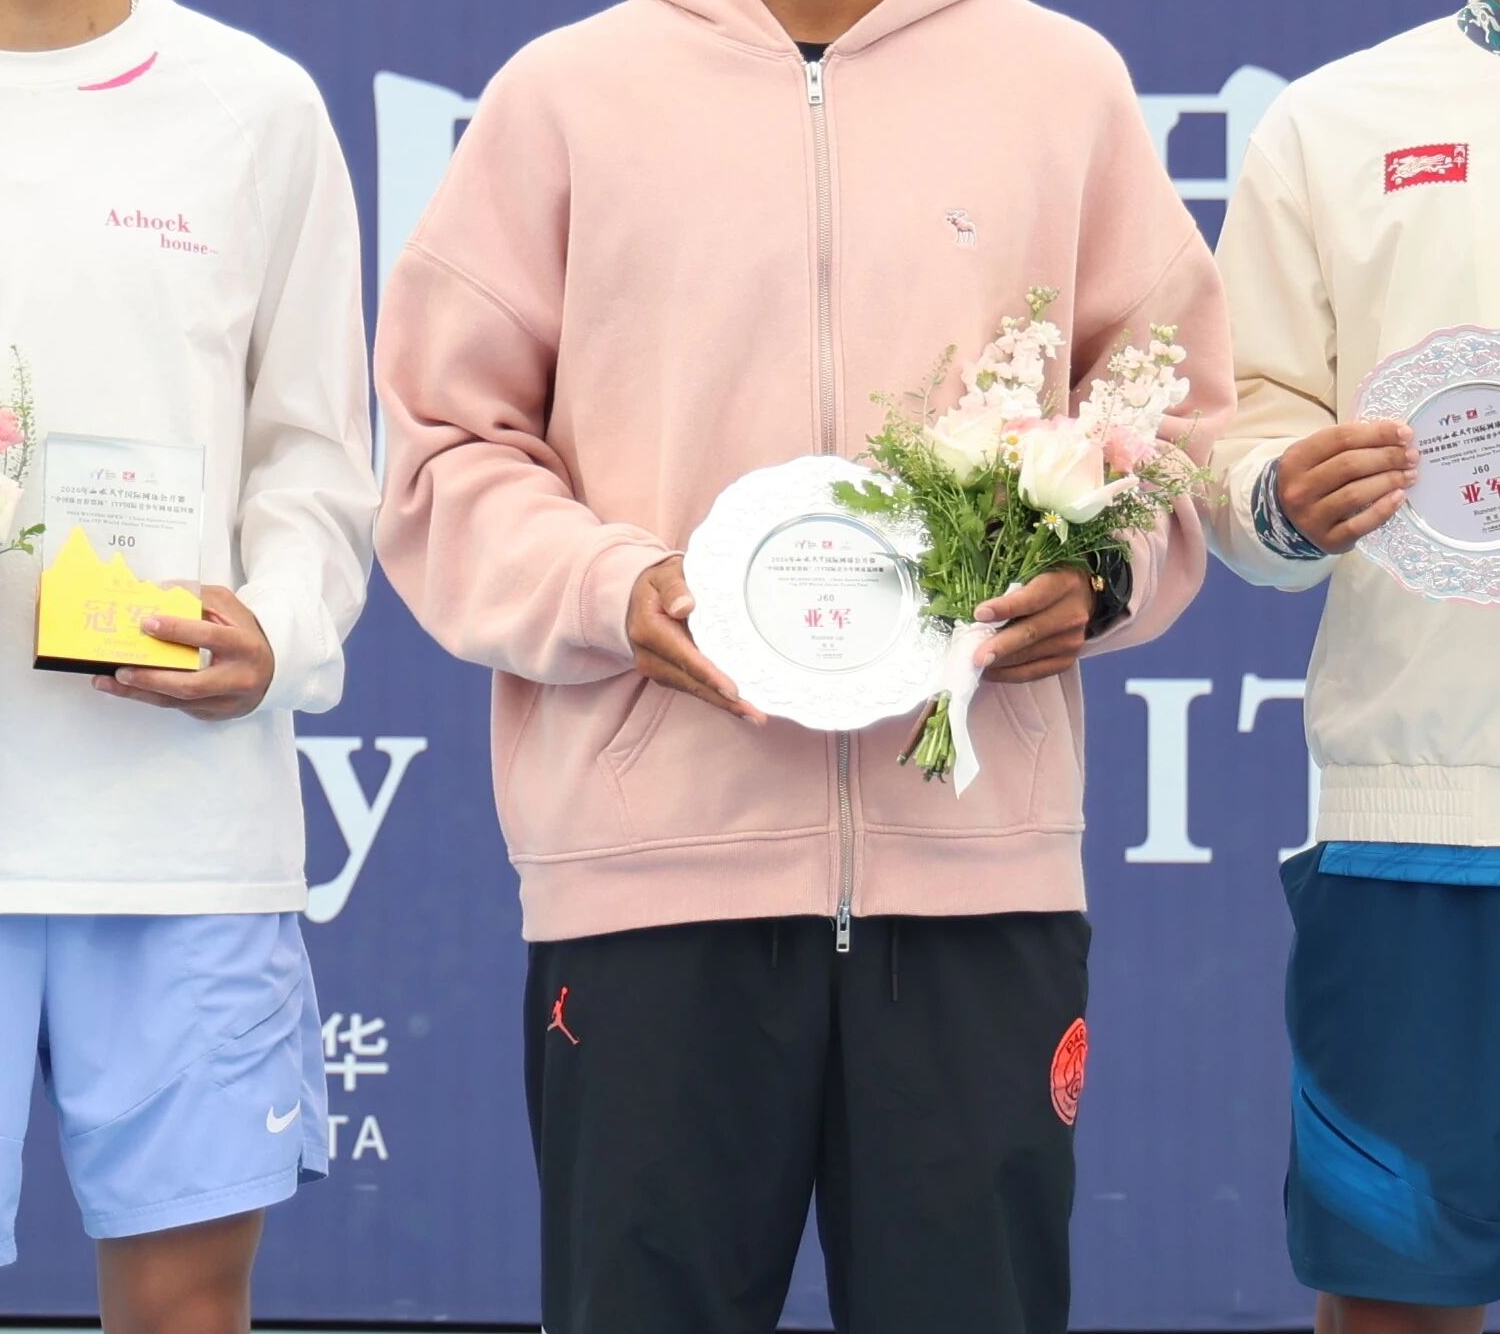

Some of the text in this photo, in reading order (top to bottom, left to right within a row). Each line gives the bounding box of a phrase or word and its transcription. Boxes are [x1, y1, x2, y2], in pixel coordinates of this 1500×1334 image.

[160, 233, 208, 255] house
[1471, 464, 1490, 476] J60
[107, 534, 136, 548] J60
[800, 607, 852, 630] 亚军
